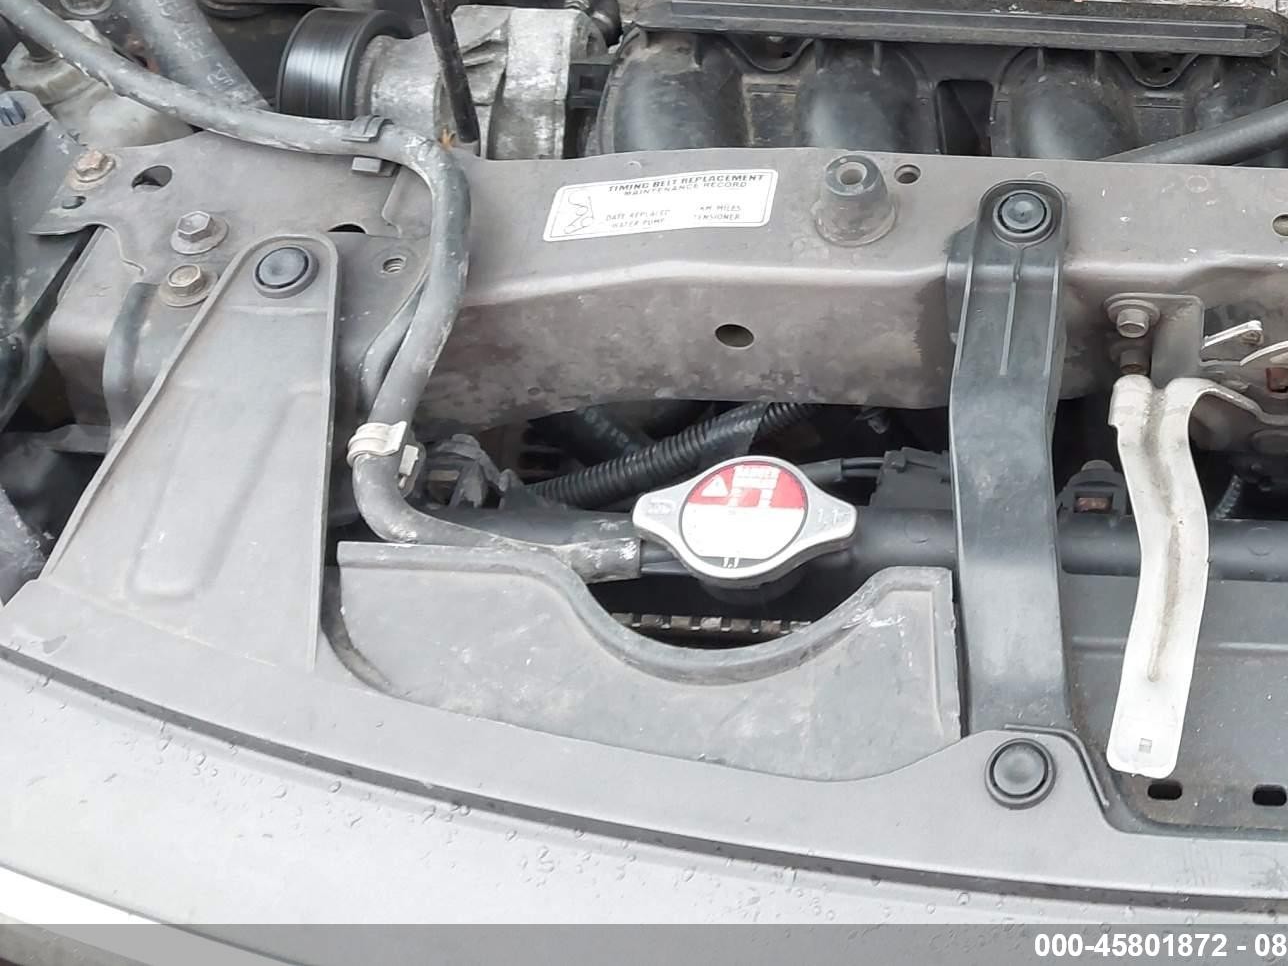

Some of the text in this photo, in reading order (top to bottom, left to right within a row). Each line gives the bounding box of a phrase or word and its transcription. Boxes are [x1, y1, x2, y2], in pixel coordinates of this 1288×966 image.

[608, 174, 765, 193] TIMING BELT REPLACEMENT
[624, 181, 747, 196] MAINTENANCE RECORD
[605, 213, 627, 222] DATE
